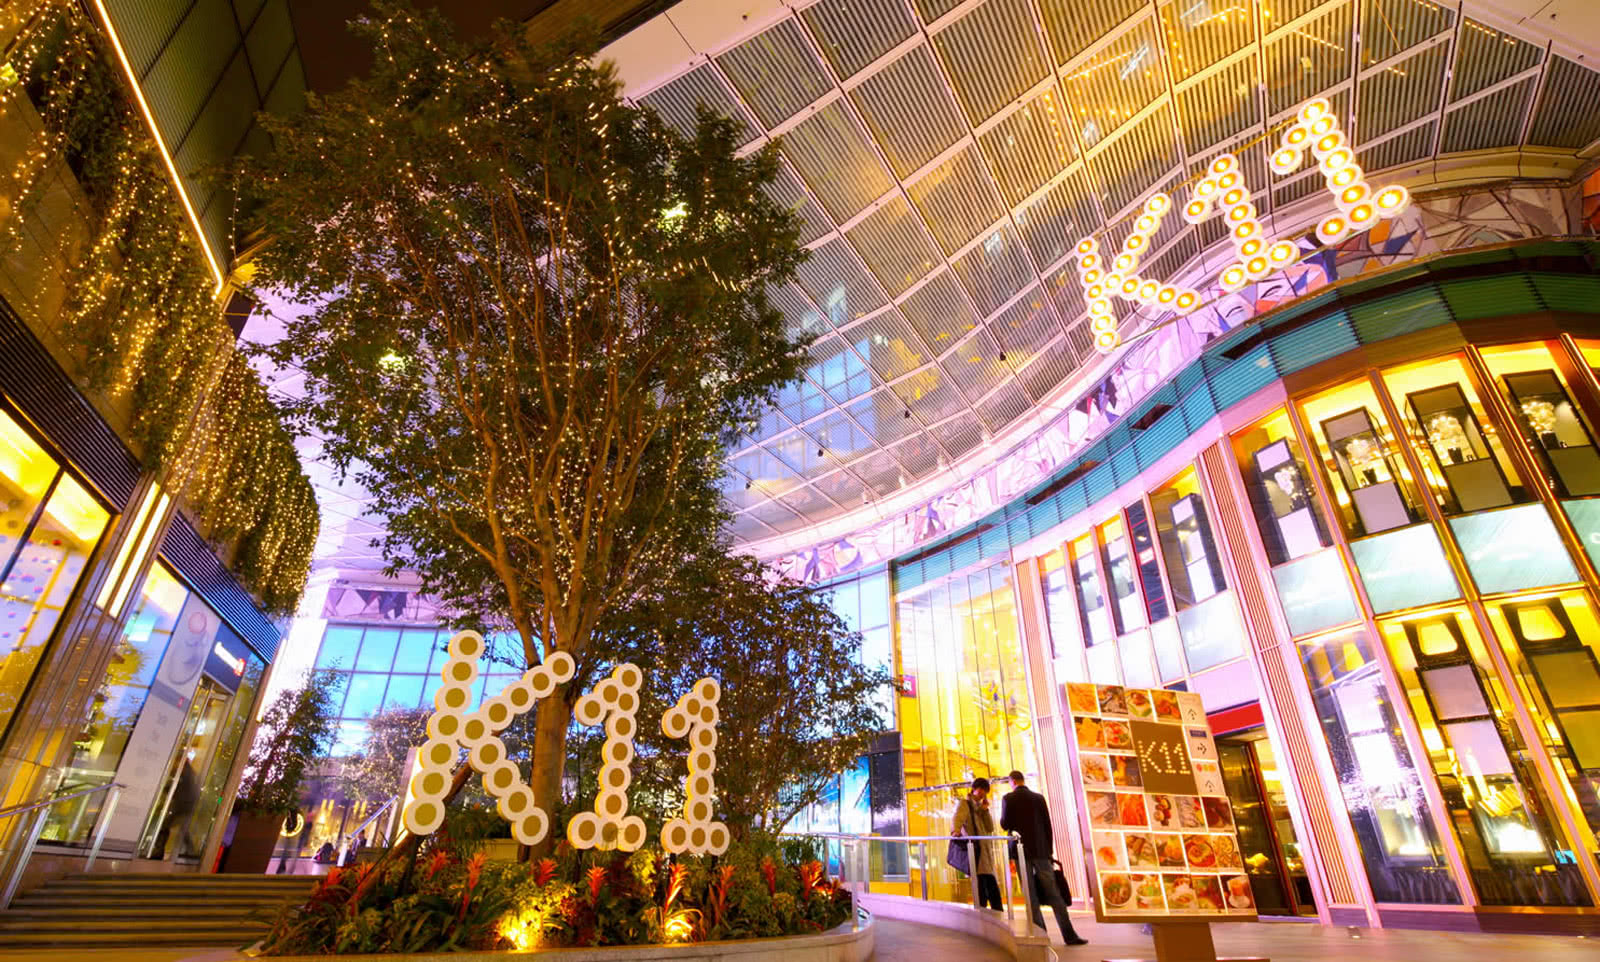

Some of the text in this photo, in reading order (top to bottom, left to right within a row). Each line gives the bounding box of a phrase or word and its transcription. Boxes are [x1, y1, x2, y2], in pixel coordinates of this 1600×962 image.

[1075, 97, 1410, 353] K11
[403, 629, 730, 856] K11
[1138, 740, 1191, 775] K11
